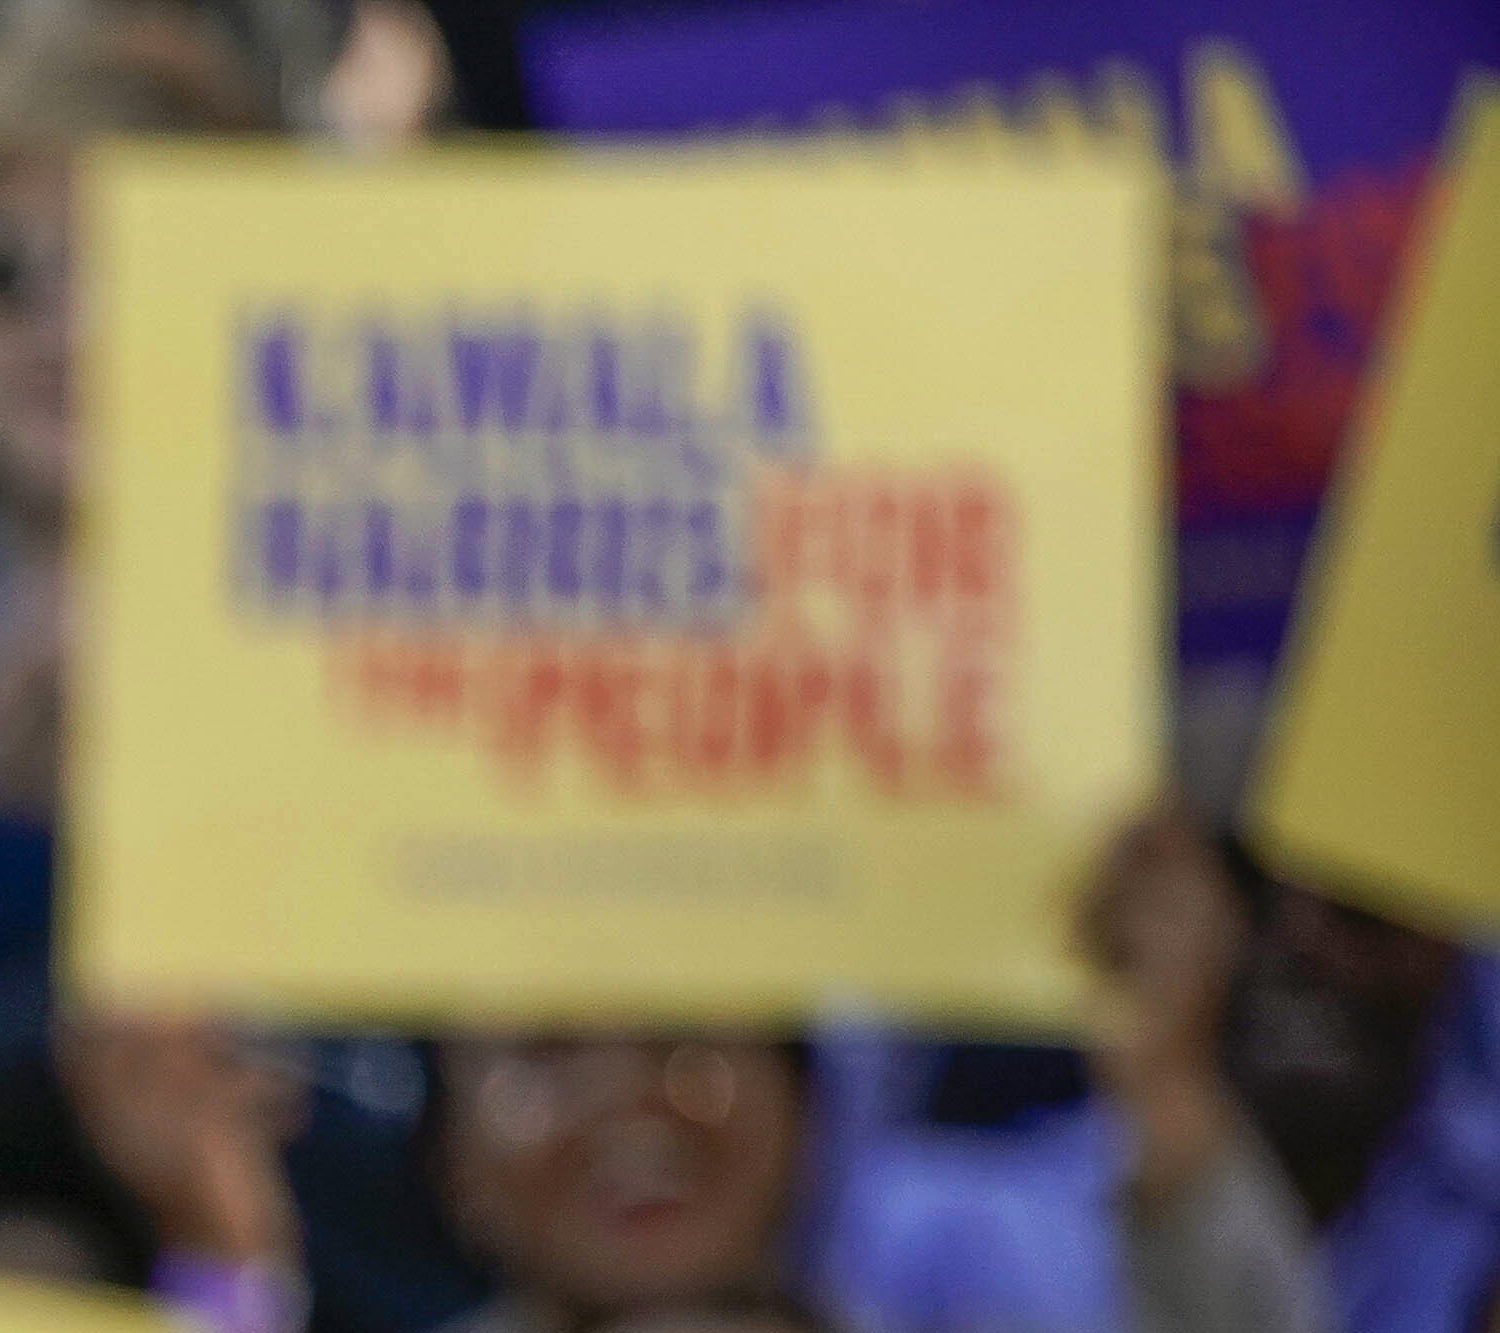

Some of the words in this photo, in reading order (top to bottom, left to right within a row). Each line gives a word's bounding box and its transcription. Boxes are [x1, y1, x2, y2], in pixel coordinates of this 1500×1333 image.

[238, 302, 812, 440] KAMALA
[236, 470, 748, 628] HARRIS
[485, 636, 1004, 800] PEOPLE
